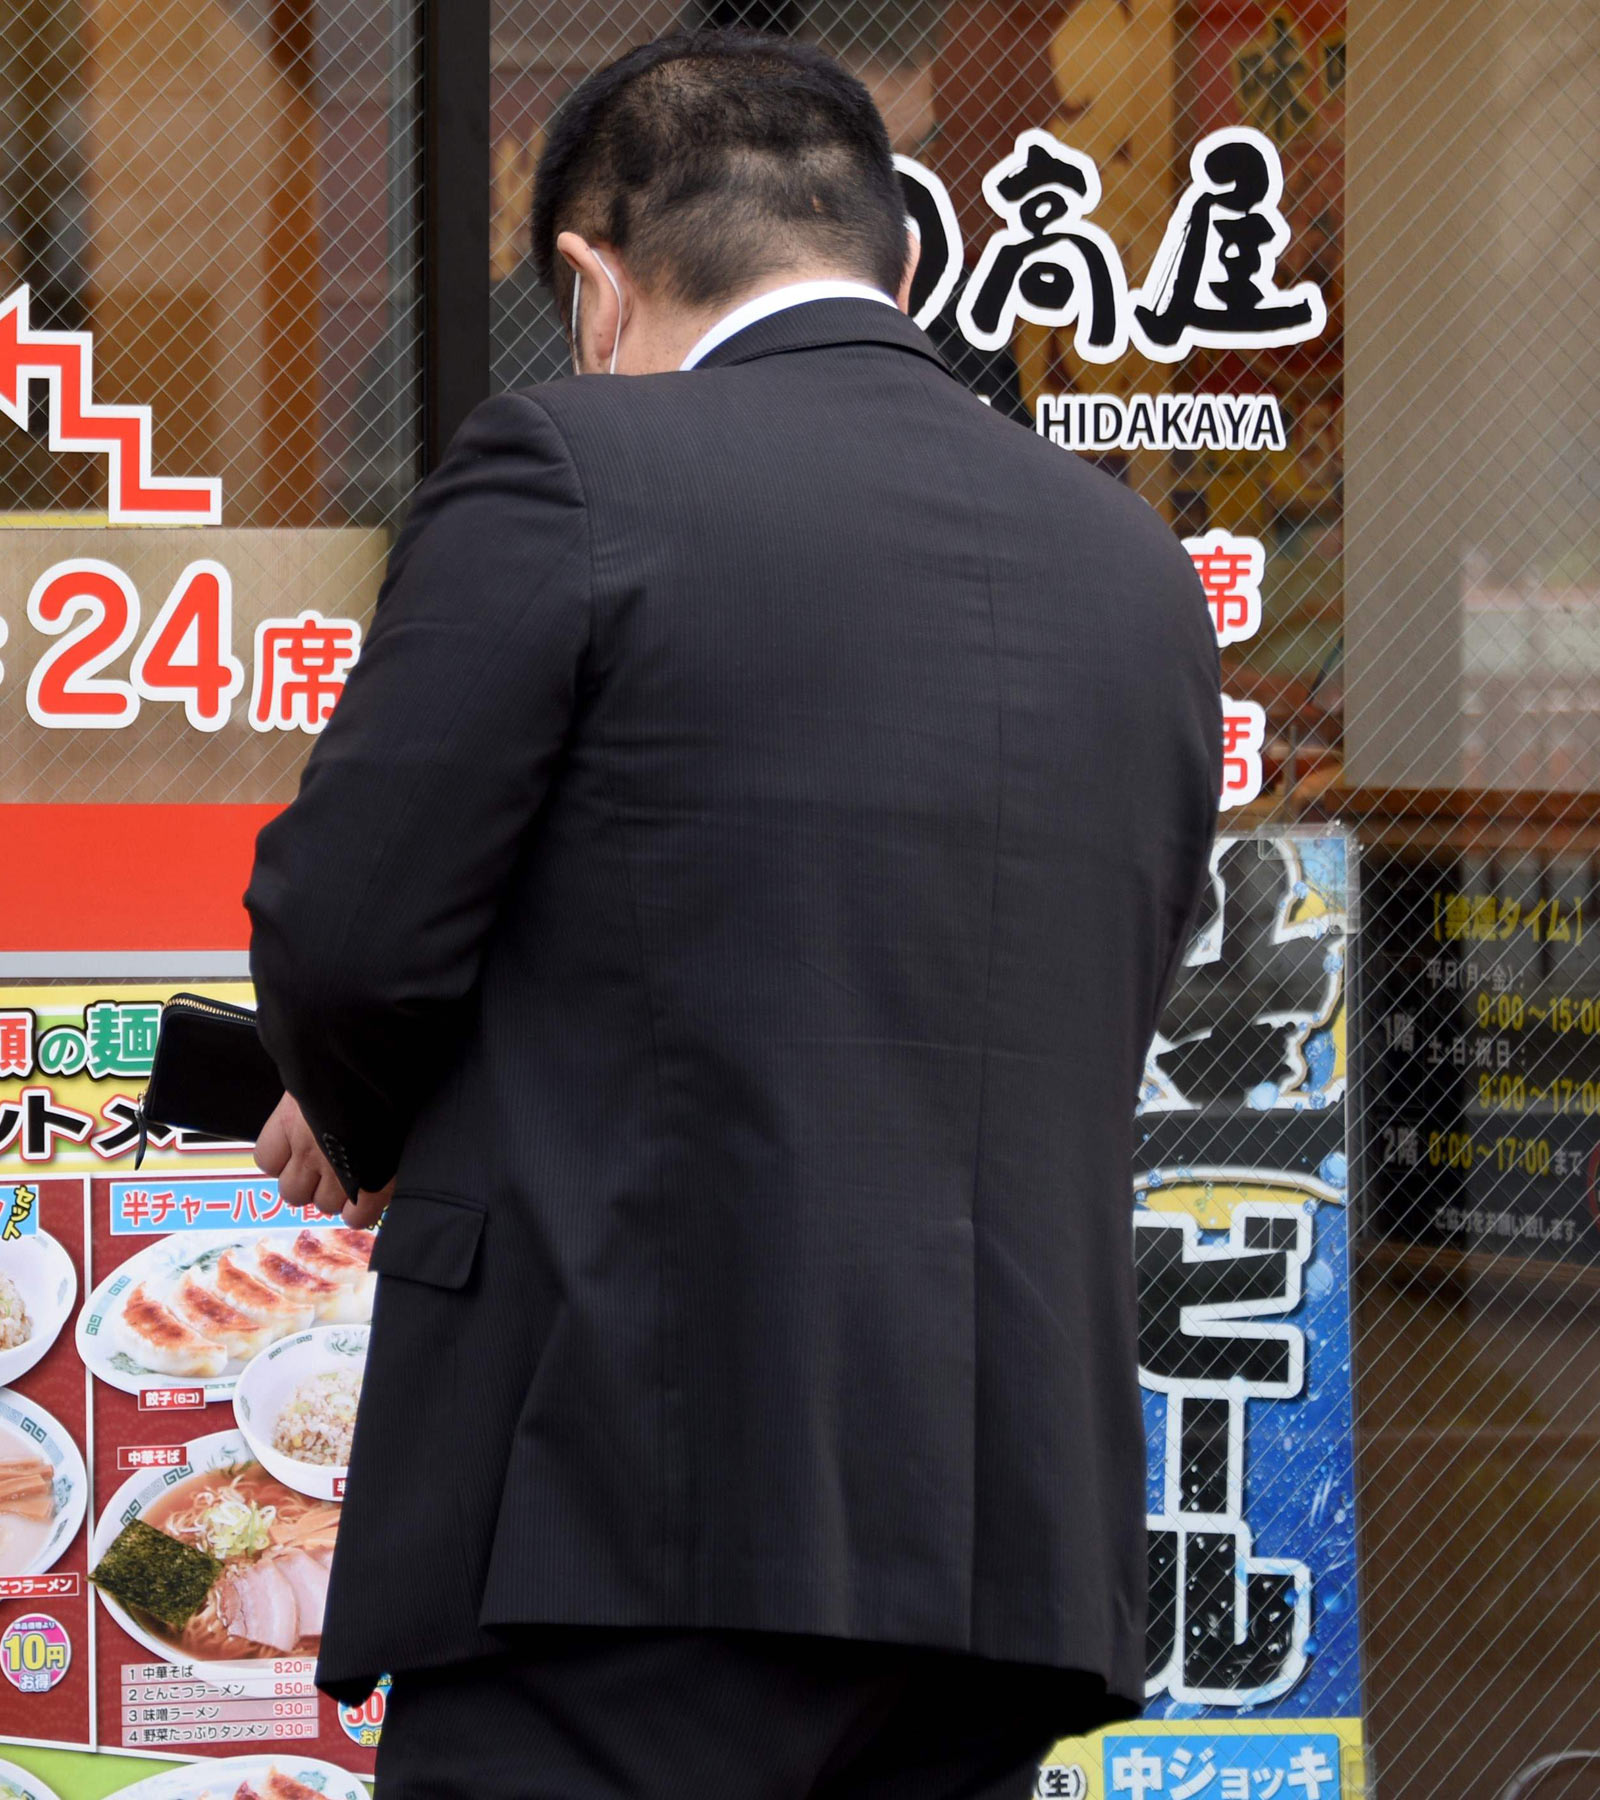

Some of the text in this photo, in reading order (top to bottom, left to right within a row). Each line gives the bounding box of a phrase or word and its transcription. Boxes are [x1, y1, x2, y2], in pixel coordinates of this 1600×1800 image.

[1041, 400, 1281, 446] HIDAKAYA
[128, 1450, 180, 1465] 中華そば
[142, 1665, 193, 1680] 中華そば
[143, 1685, 245, 1701] とんこつラーメン
[143, 1707, 220, 1722] 味噌ラーメン
[143, 1724, 269, 1743] 野菜たっぷりタンメン
